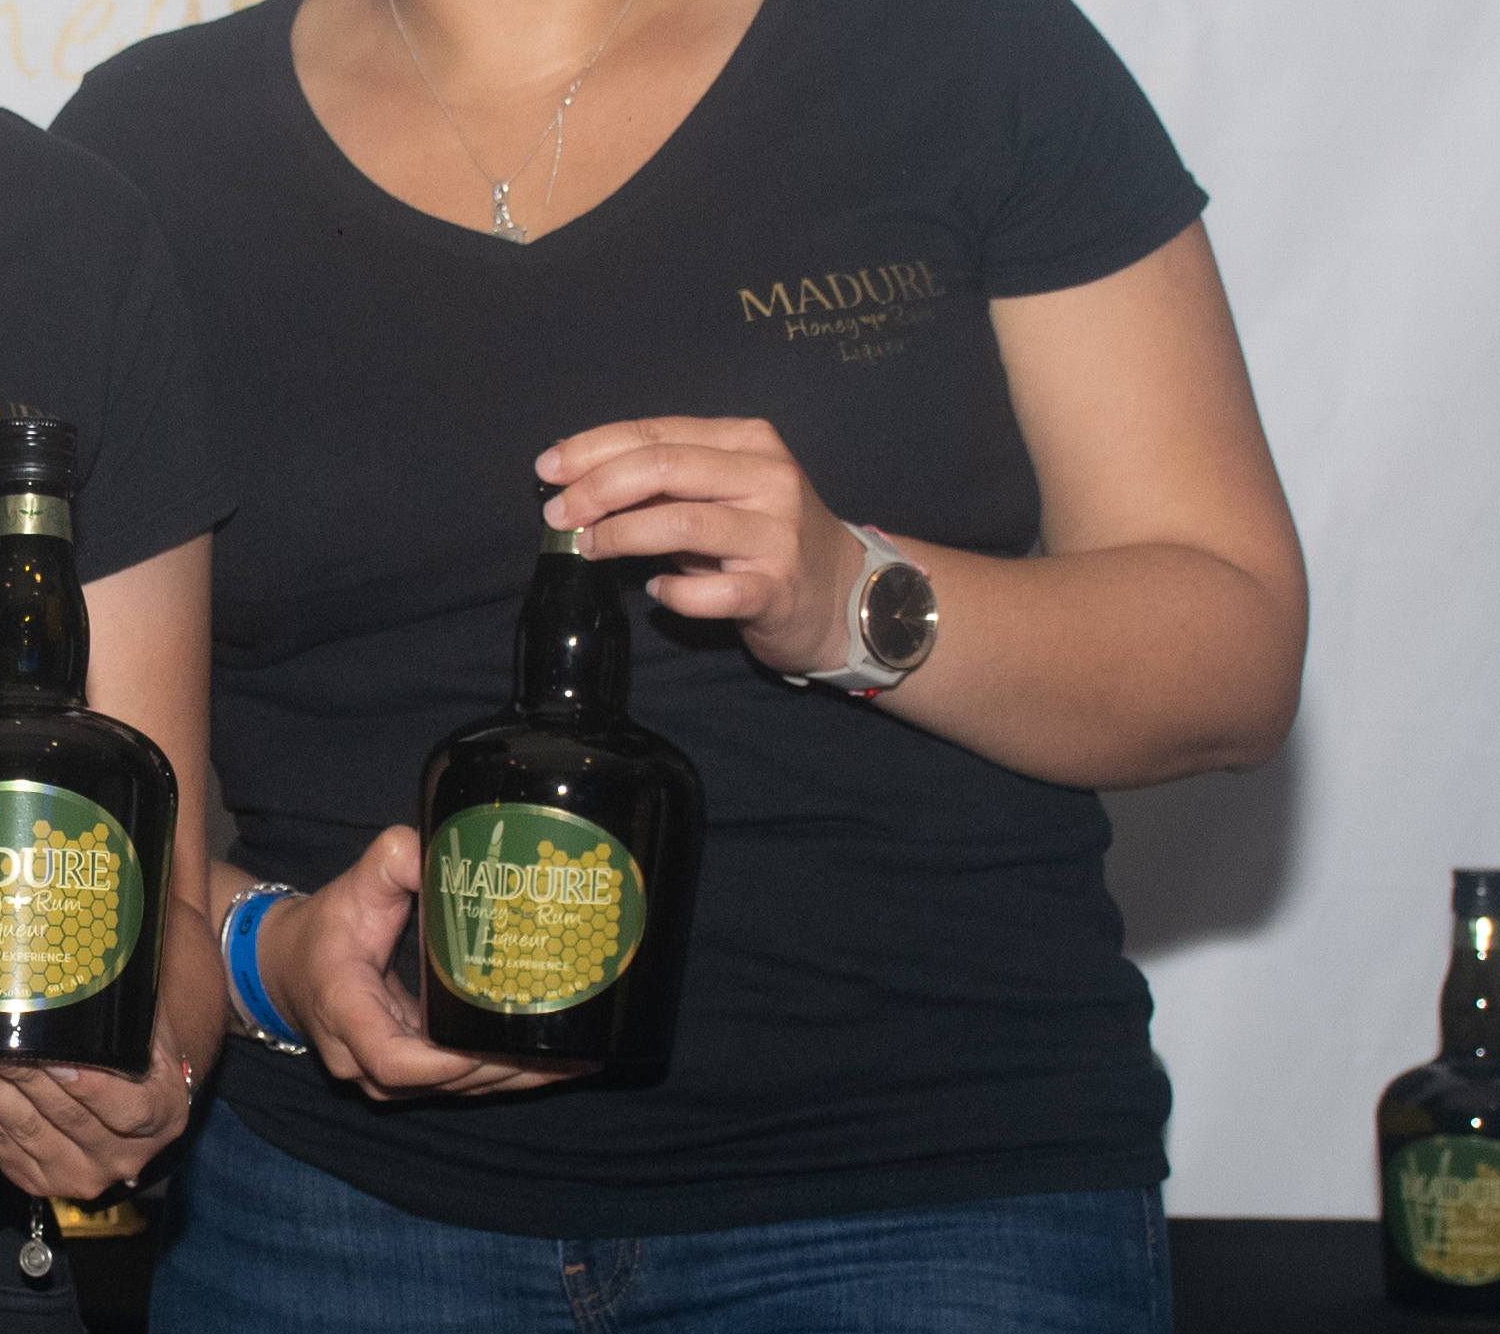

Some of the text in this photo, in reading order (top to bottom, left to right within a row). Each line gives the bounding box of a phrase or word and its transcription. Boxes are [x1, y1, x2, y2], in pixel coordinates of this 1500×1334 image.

[738, 260, 947, 322] MADURE
[785, 313, 860, 342] Honey
[440, 856, 613, 905] MADURE
[32, 889, 83, 913] Rum
[457, 900, 582, 928] Honey Rum
[481, 925, 550, 953] Liqueur
[2, 951, 71, 963] EXPERIENCE
